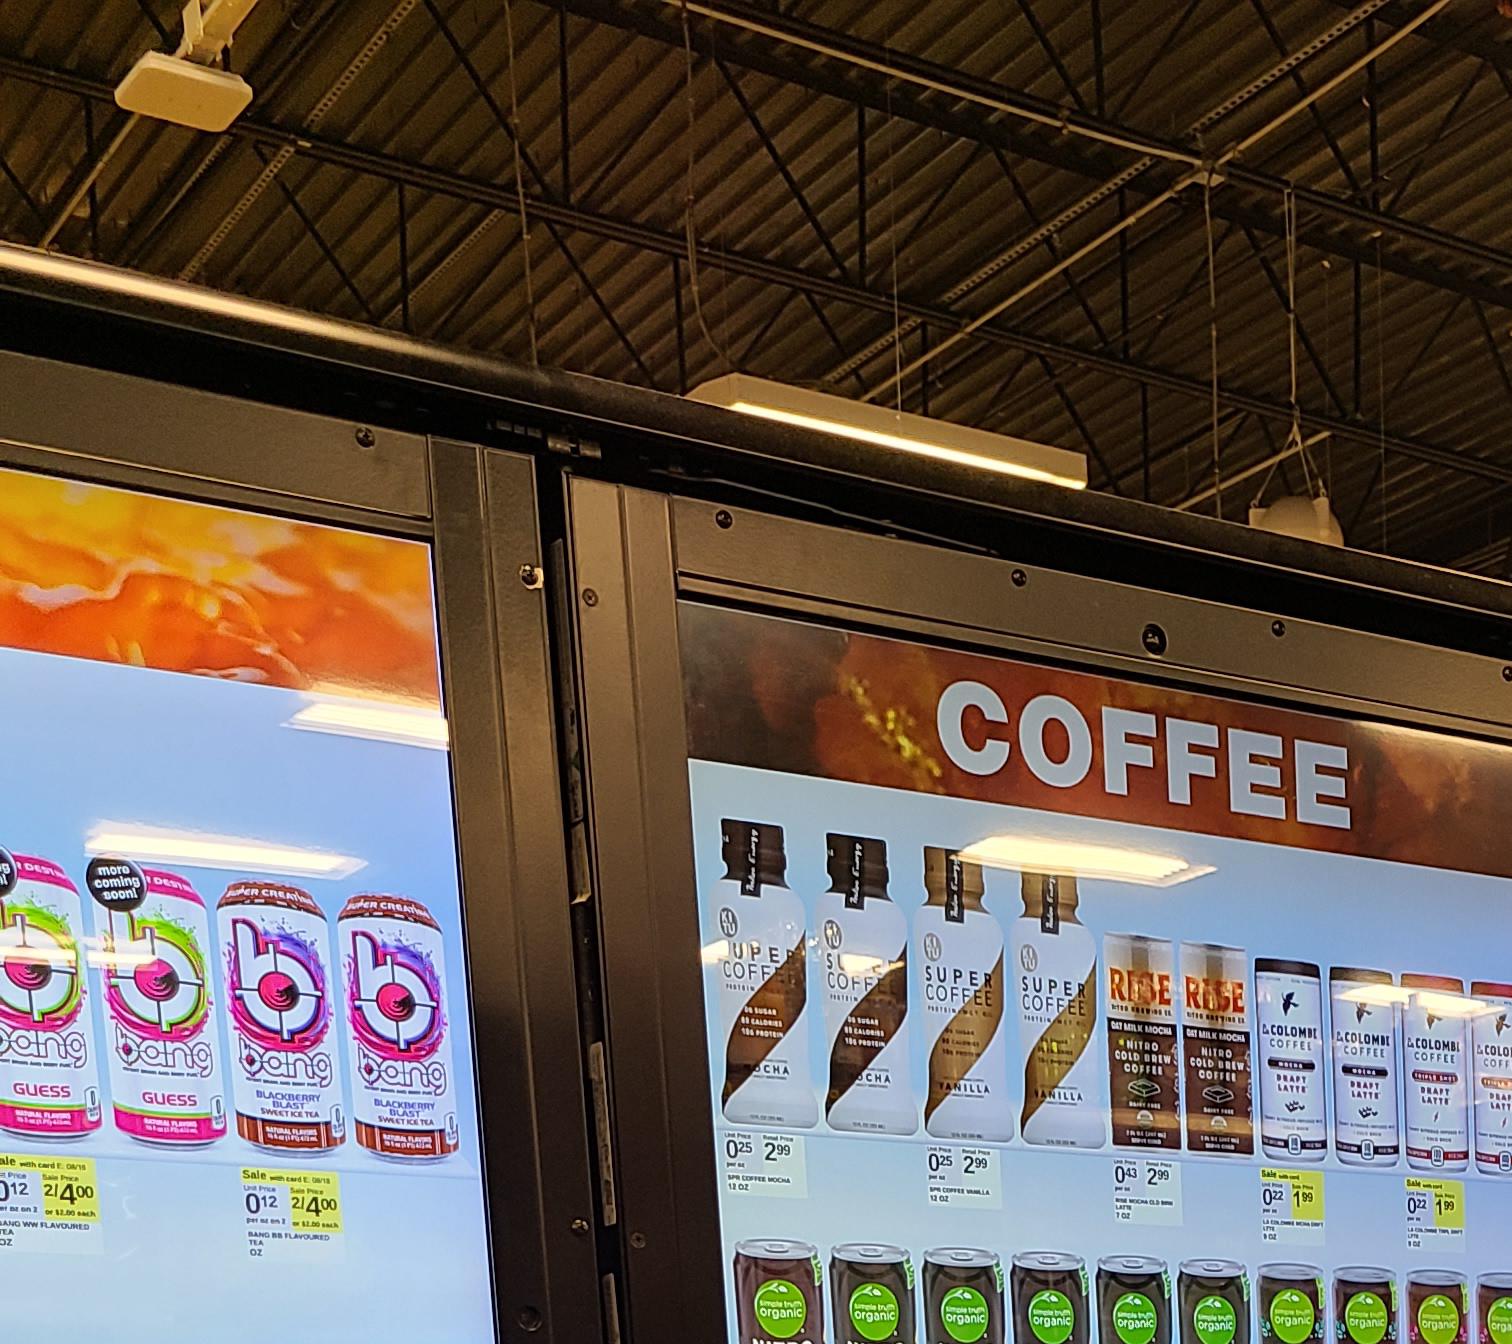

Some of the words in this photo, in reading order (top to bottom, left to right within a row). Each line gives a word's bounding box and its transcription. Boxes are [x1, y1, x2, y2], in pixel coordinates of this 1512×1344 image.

[937, 680, 1352, 830] COFFEE
[97, 865, 130, 877] more
[94, 875, 140, 889] coming
[102, 888, 138, 901] soon!
[925, 965, 992, 989] SUPER
[926, 981, 992, 1007] COFFEE
[1109, 967, 1172, 1006] RISE
[1185, 976, 1245, 1014] RISE
[115, 1023, 213, 1078] bang
[1126, 1040, 1159, 1052] NITRO
[238, 1039, 333, 1088] bang
[1114, 1050, 1140, 1062] COLD
[1144, 1052, 1172, 1065] BREW
[357, 1047, 447, 1096] bang
[1123, 1061, 1163, 1076] COFFEE
[13, 1081, 71, 1099] GUESS
[938, 1082, 991, 1094] VANILLA
[142, 1091, 198, 1107] GUESS
[256, 1090, 321, 1103] BLACKBERRY
[272, 1099, 306, 1110] BLAST
[373, 1098, 435, 1111] BLACKBERRY
[389, 1107, 421, 1118] BLAST
[242, 1169, 267, 1181] Sale
[249, 1239, 264, 1247] TEA
[249, 1248, 262, 1257] OZ
[759, 1305, 803, 1322] organic
